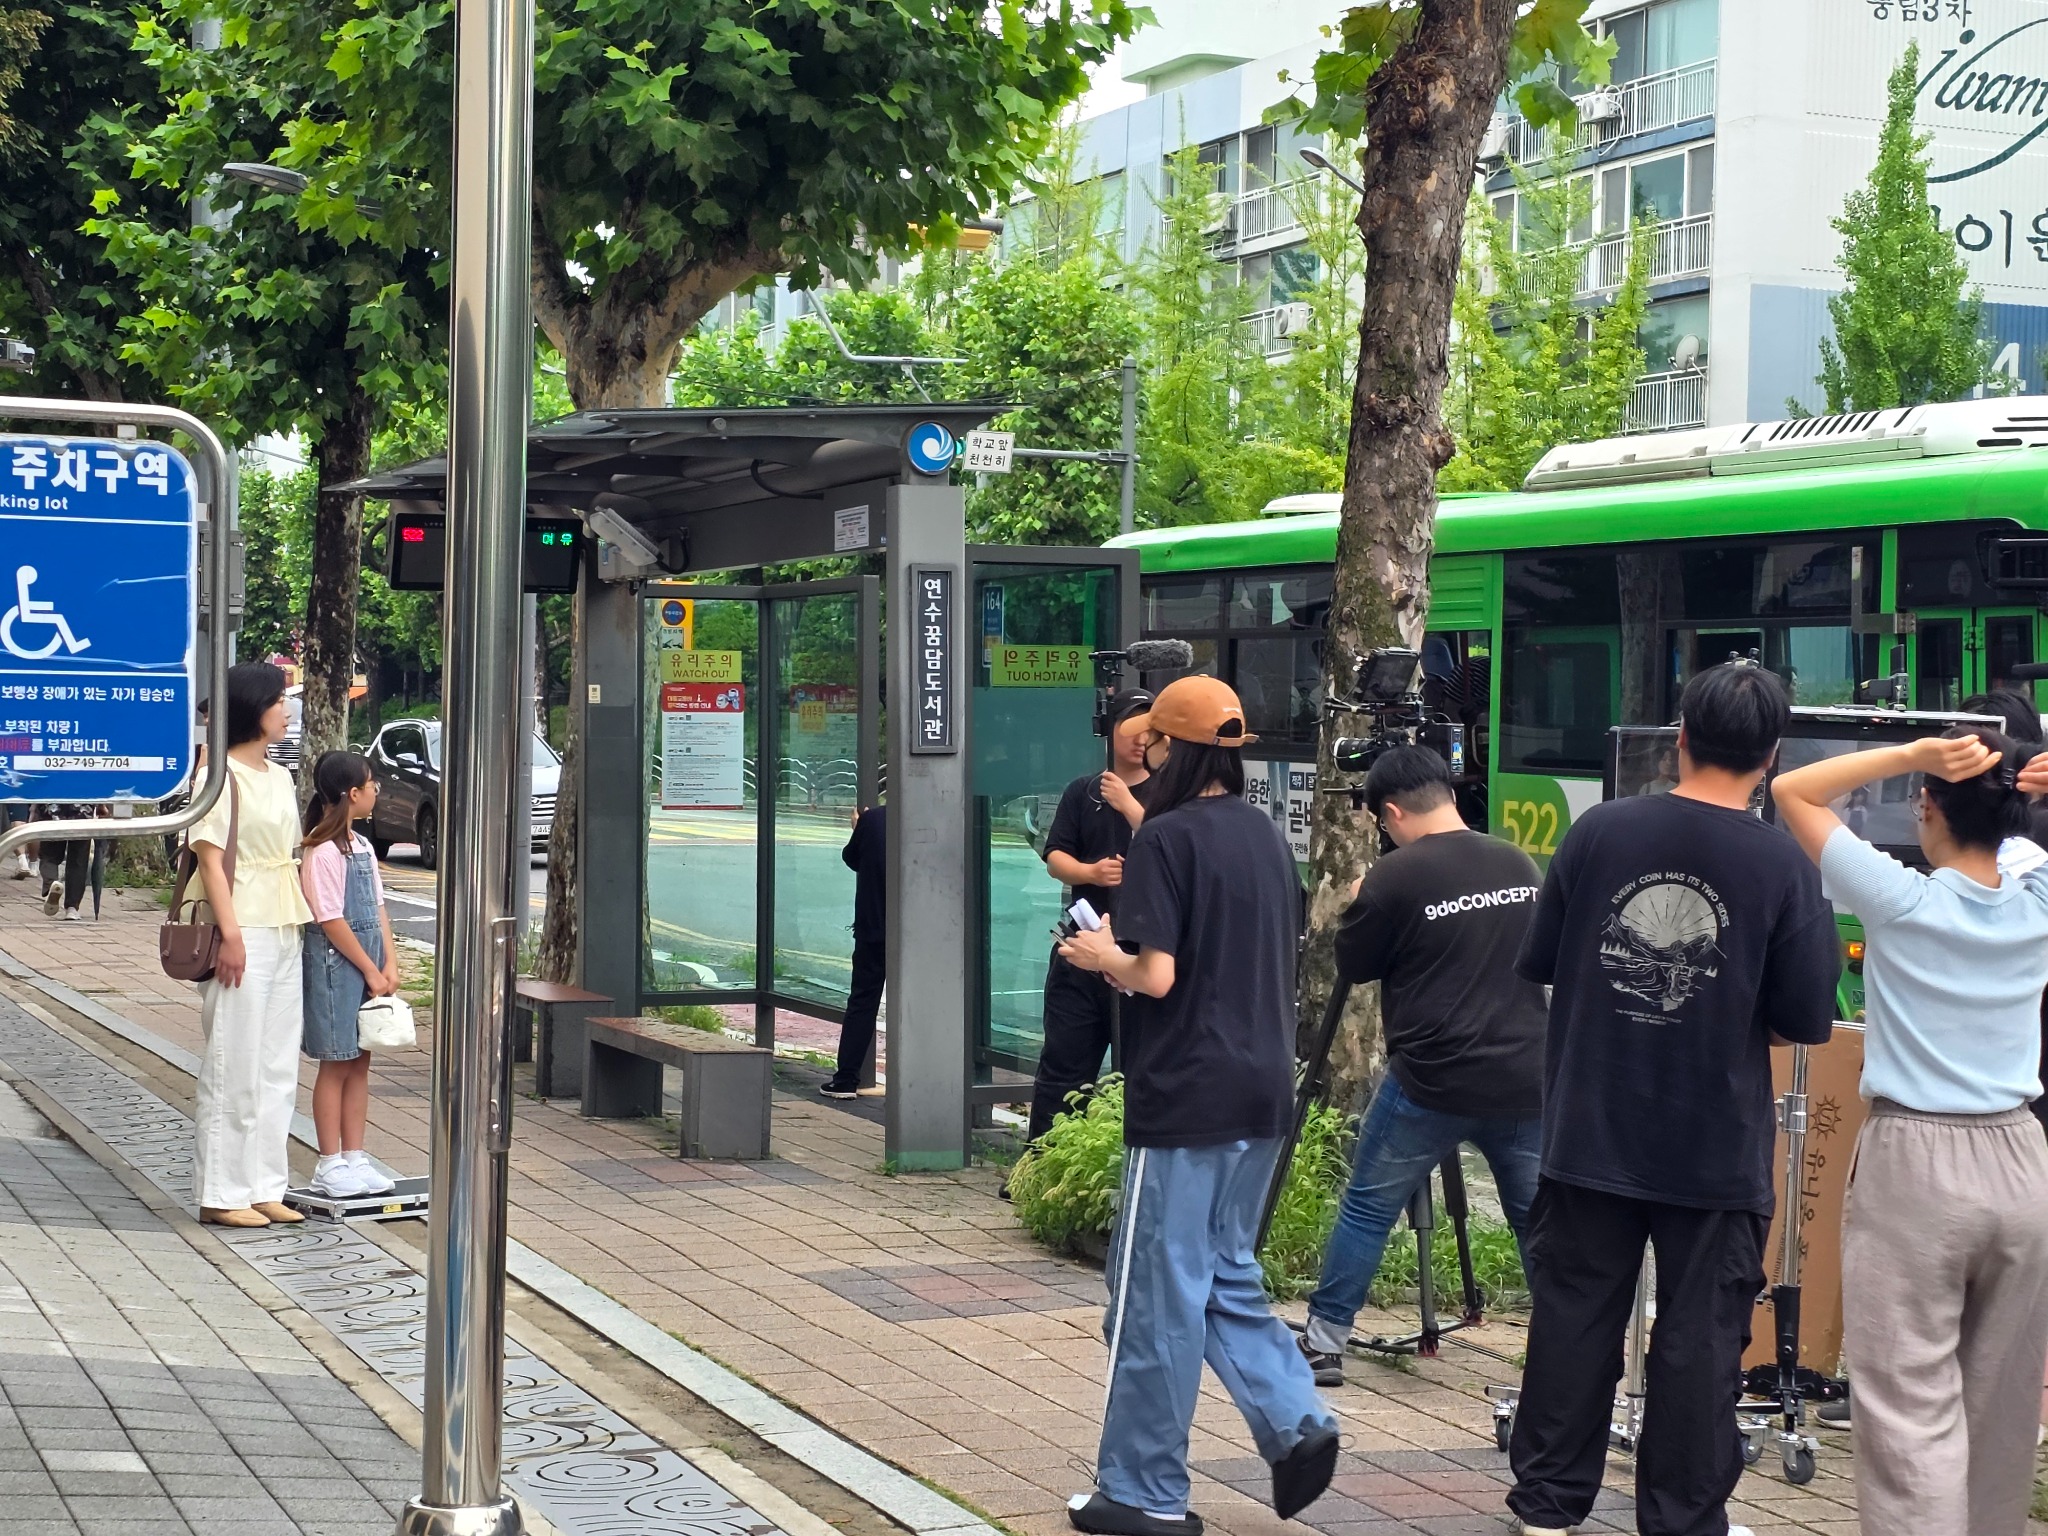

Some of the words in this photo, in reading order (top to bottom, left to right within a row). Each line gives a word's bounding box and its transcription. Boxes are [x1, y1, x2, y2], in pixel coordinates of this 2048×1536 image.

[969, 453, 1006, 467] 천천히
[12, 446, 168, 496] 주차구역
[45, 496, 68, 510] lot
[671, 653, 732, 668] 유리주의
[673, 670, 709, 678] WATCH
[711, 670, 729, 678] OUT
[1, 686, 38, 700] 보행상
[42, 686, 79, 700] 장애가
[83, 687, 107, 701] 있는
[111, 688, 135, 702] 자가
[139, 688, 175, 702] 탑승한
[5, 720, 42, 734] 부착된
[46, 720, 71, 734] 차량
[45, 757, 130, 768] 032-749-7704
[1503, 800, 1558, 855] 522
[1424, 886, 1539, 921] 9doCONCEPT
[1611, 880, 1637, 904] EVERY
[1639, 872, 1662, 884] COIN
[1665, 871, 1686, 882] HAS
[1686, 875, 1701, 887] ITS
[1702, 882, 1719, 902] TWO
[1715, 902, 1730, 928] SIDES
